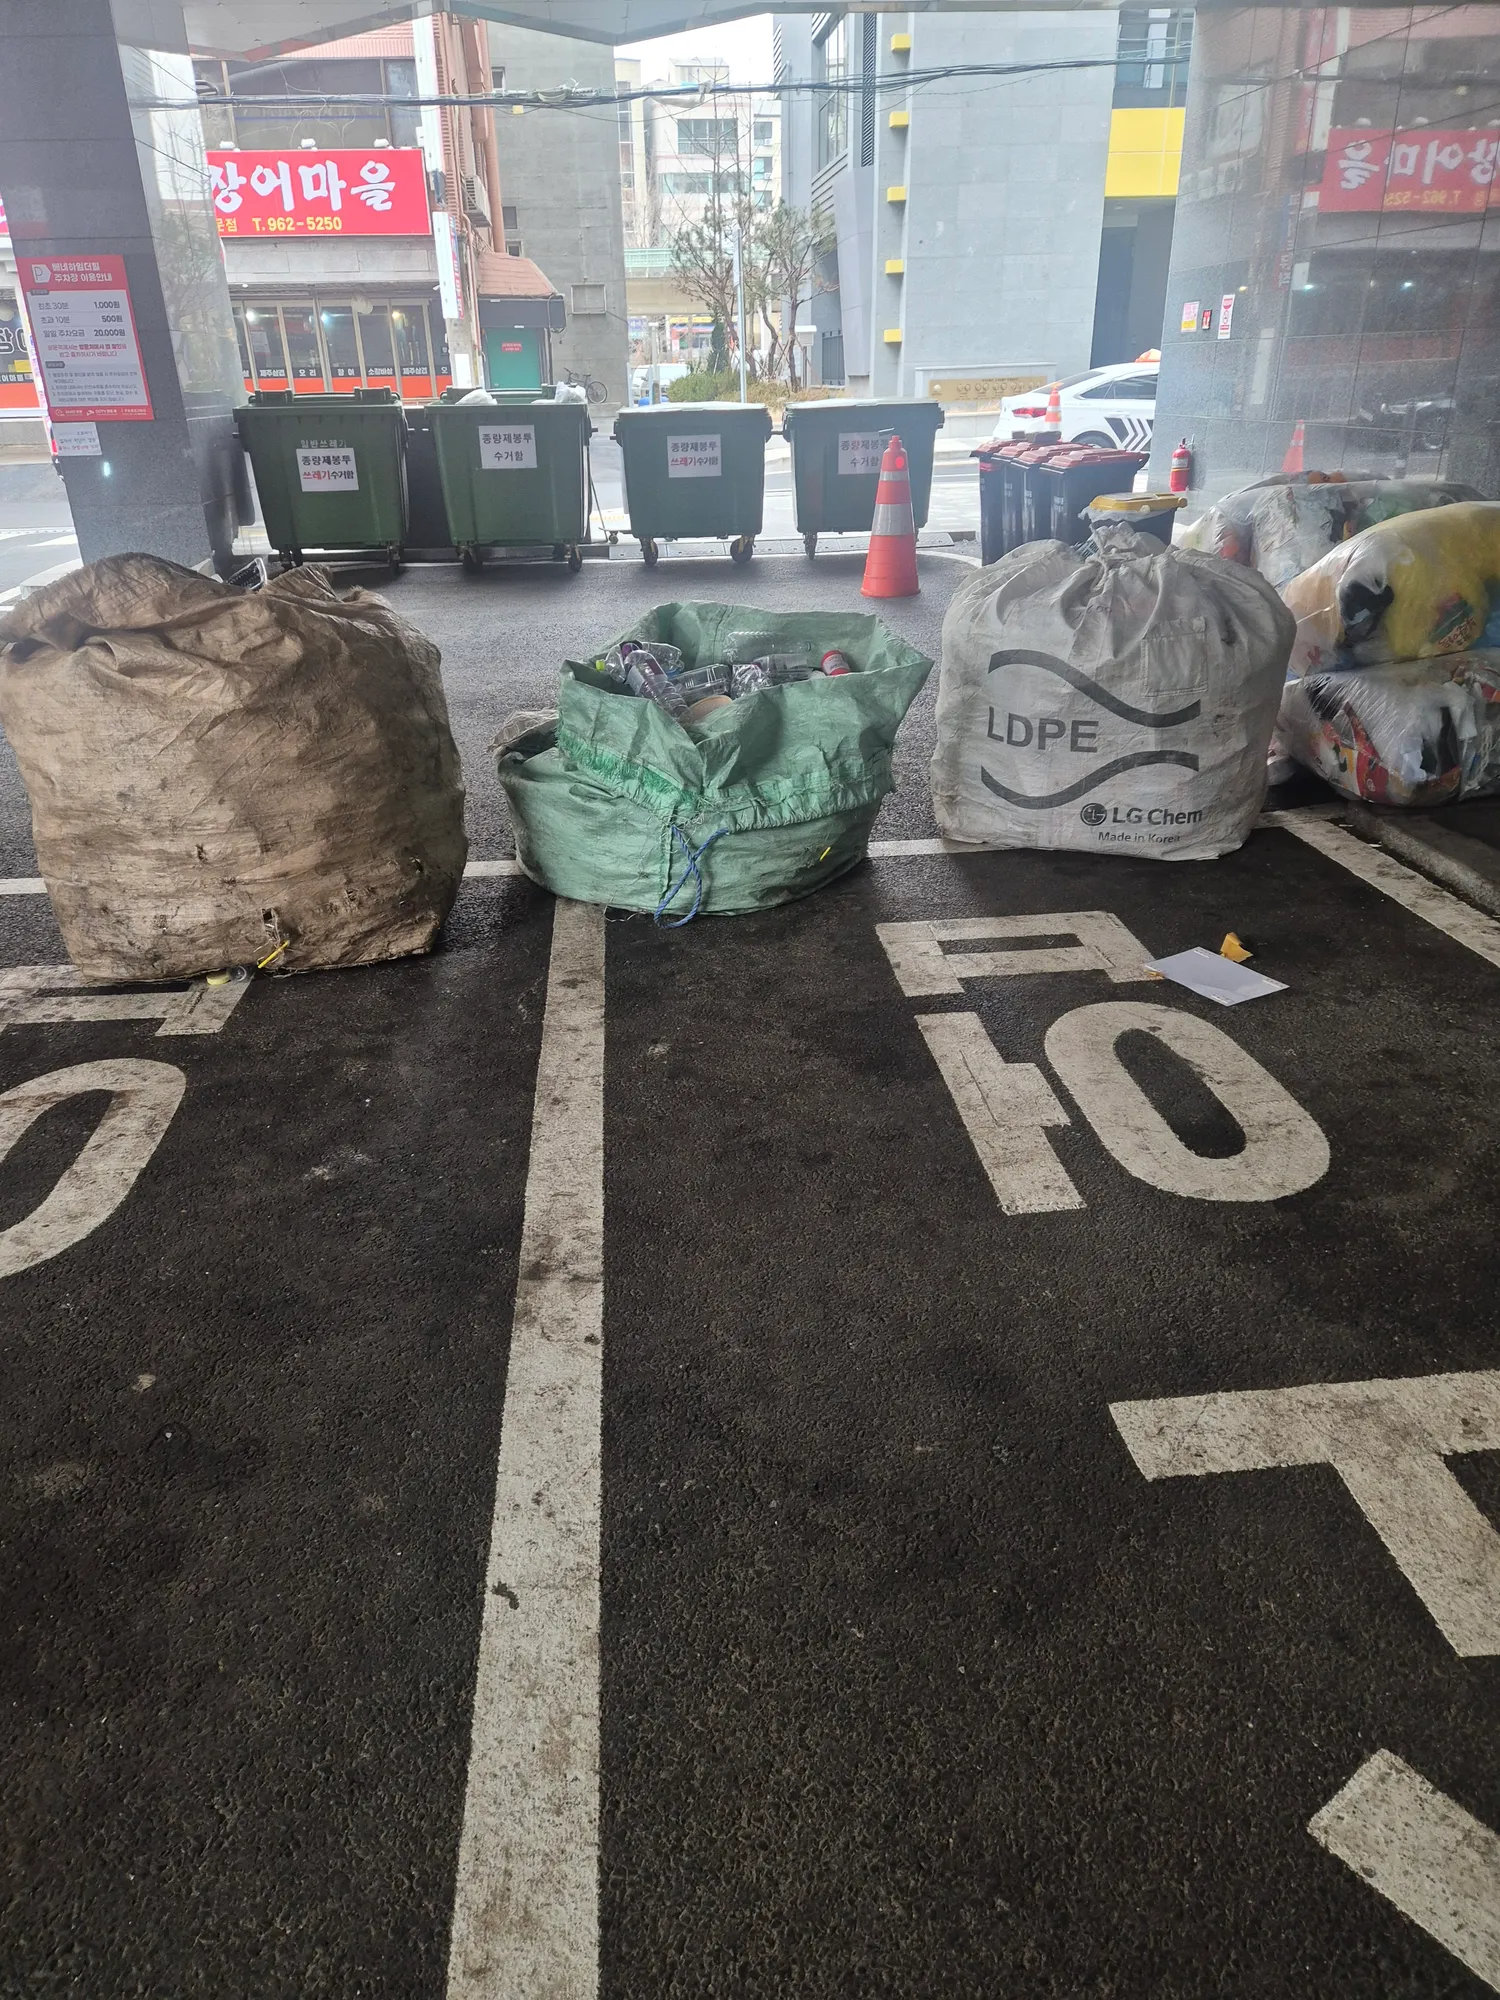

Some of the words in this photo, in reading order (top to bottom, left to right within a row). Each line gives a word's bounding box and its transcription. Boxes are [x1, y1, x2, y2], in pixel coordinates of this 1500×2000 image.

[208, 160, 396, 213] 장어마을
[252, 217, 342, 231] T.962-5250
[55, 273, 78, 282] 주차장
[80, 272, 113, 282] 이용안내
[52, 302, 69, 310] 30분
[41, 316, 54, 324] 초과
[55, 316, 70, 324] 10분
[101, 314, 124, 323] 500원
[58, 329, 85, 338] 주차요금
[482, 432, 532, 444] 종량제봉투
[301, 439, 347, 449] 일반쓰레기
[671, 441, 718, 452] 종량제봉투
[302, 455, 352, 466] 종량제봉투
[494, 450, 524, 462] 수거함
[850, 456, 880, 467] 수거함
[987, 706, 1099, 753] LDPE
[1112, 807, 1144, 824] LG
[1148, 808, 1203, 825] Chem
[1099, 832, 1131, 843] Made
[1135, 833, 1144, 842] in
[1149, 834, 1181, 844] Korea
